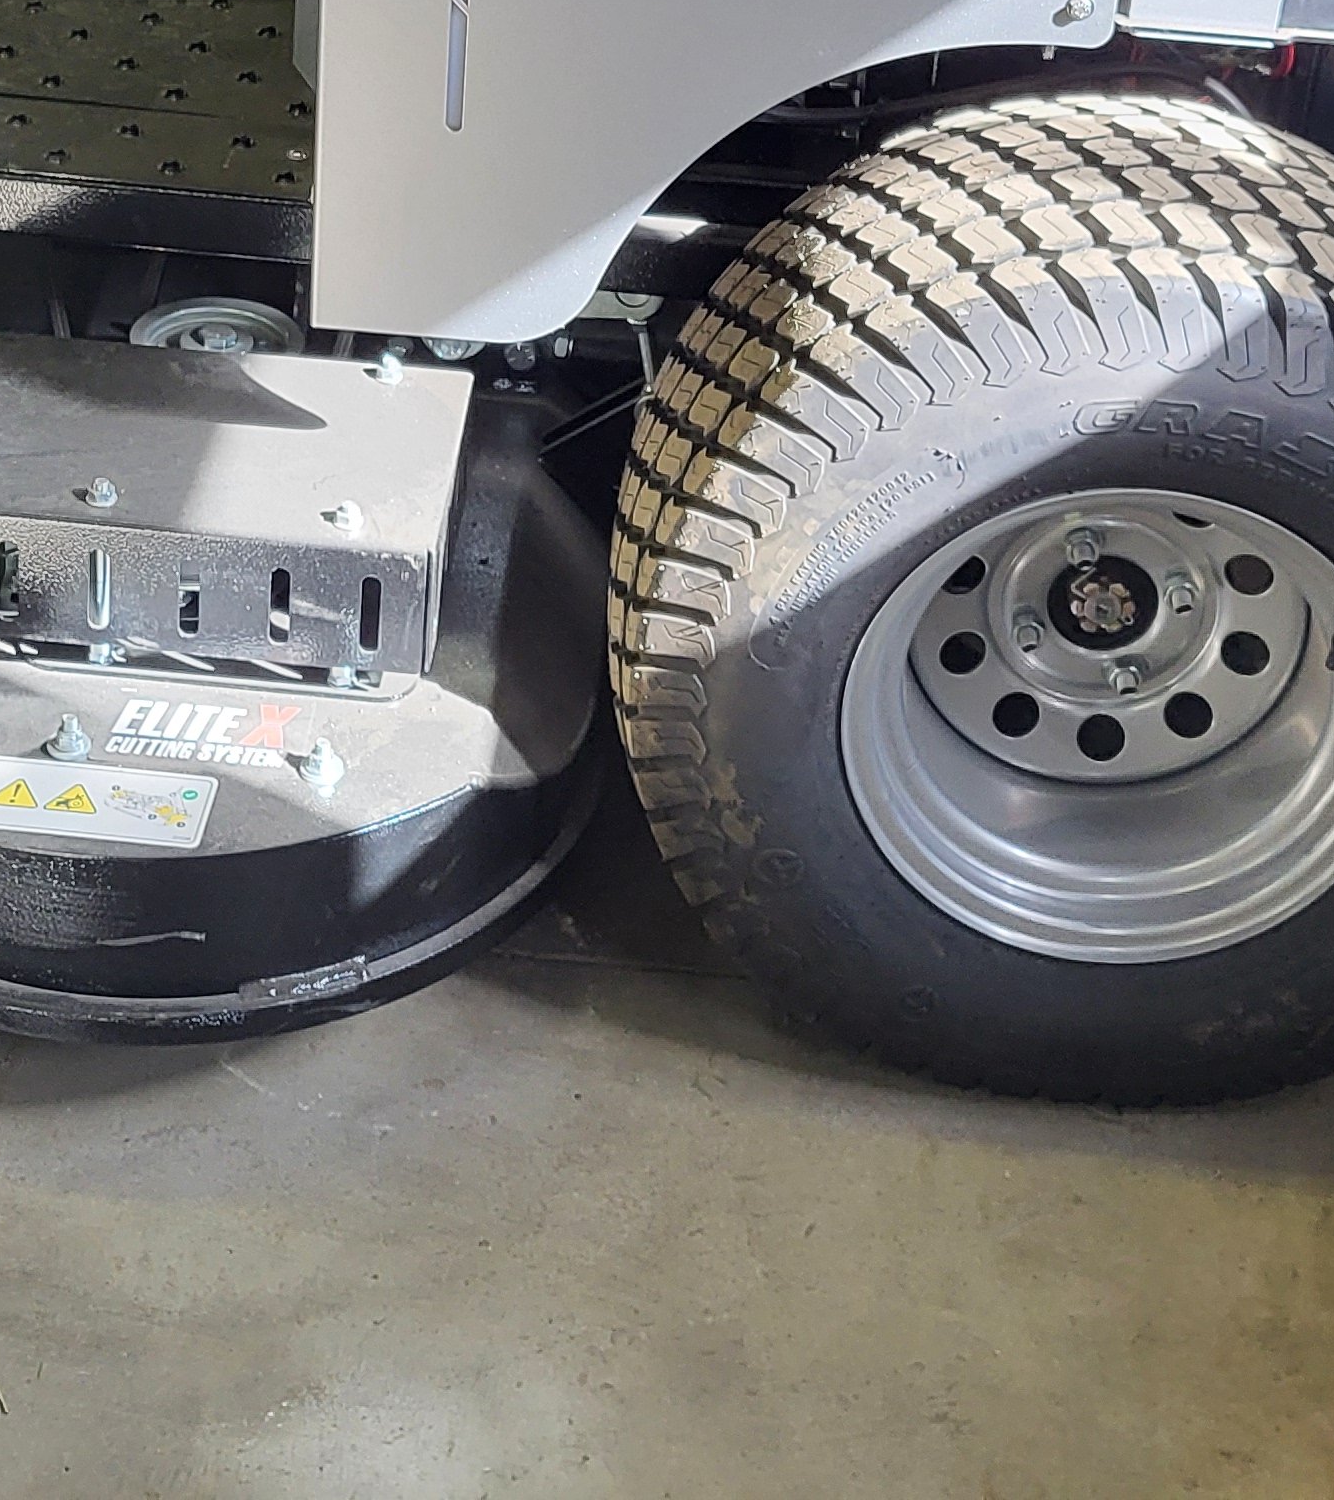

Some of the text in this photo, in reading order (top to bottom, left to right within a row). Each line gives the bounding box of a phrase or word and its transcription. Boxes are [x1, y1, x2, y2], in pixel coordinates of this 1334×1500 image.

[110, 698, 249, 745] ELITE
[104, 735, 287, 770] CUTTING SYSTEM
